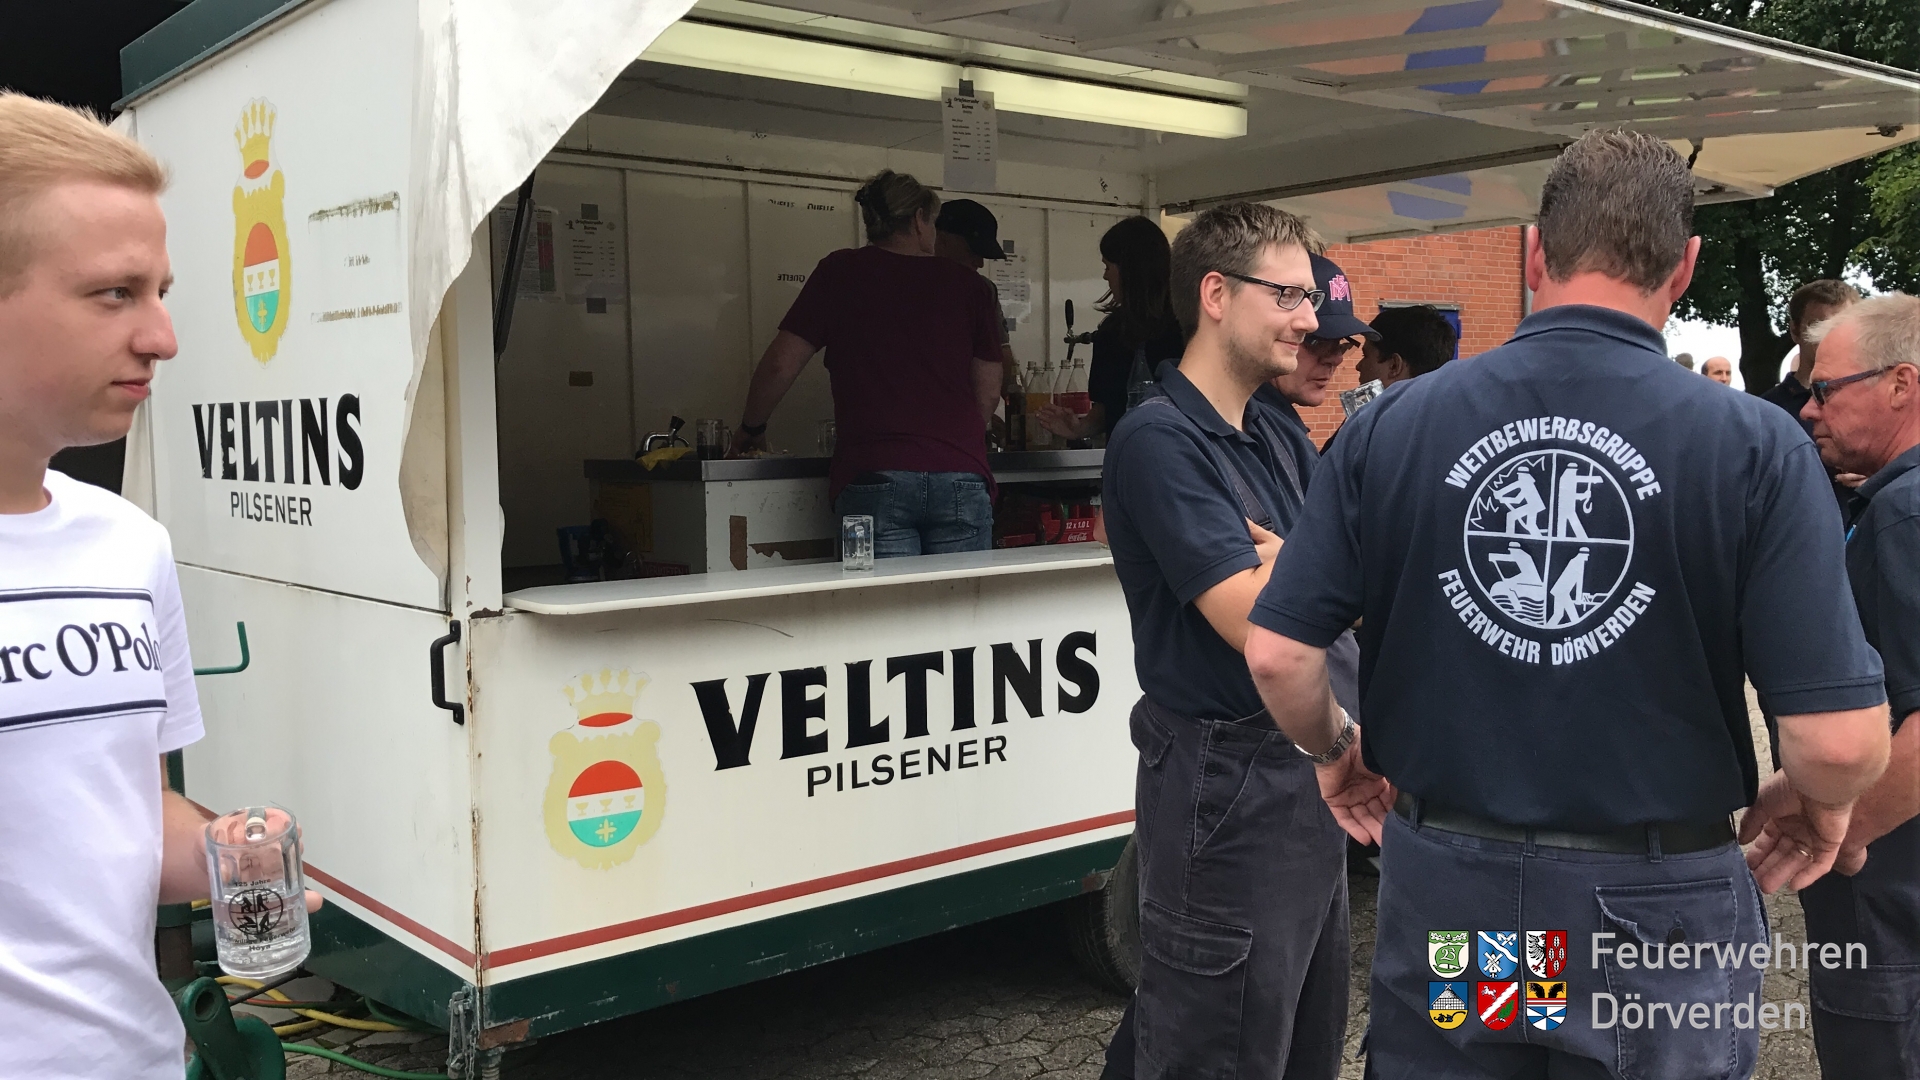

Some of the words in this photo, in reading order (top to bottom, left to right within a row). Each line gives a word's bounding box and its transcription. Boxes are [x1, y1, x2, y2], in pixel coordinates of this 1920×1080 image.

[192, 393, 364, 490] VELTINS
[1444, 416, 1662, 501] WETTBEWERBSGRUPPE
[230, 491, 312, 527] PILSENER
[1065, 522, 1072, 530] 12
[1437, 568, 1541, 664] FEUERWEHR
[1550, 581, 1657, 666] DÖRVERDEN
[0, 643, 52, 684] rc
[688, 629, 1101, 771] VELTINS
[807, 735, 1008, 797] PILSENER
[250, 878, 271, 887] Jahre
[248, 944, 271, 952] Hoya
